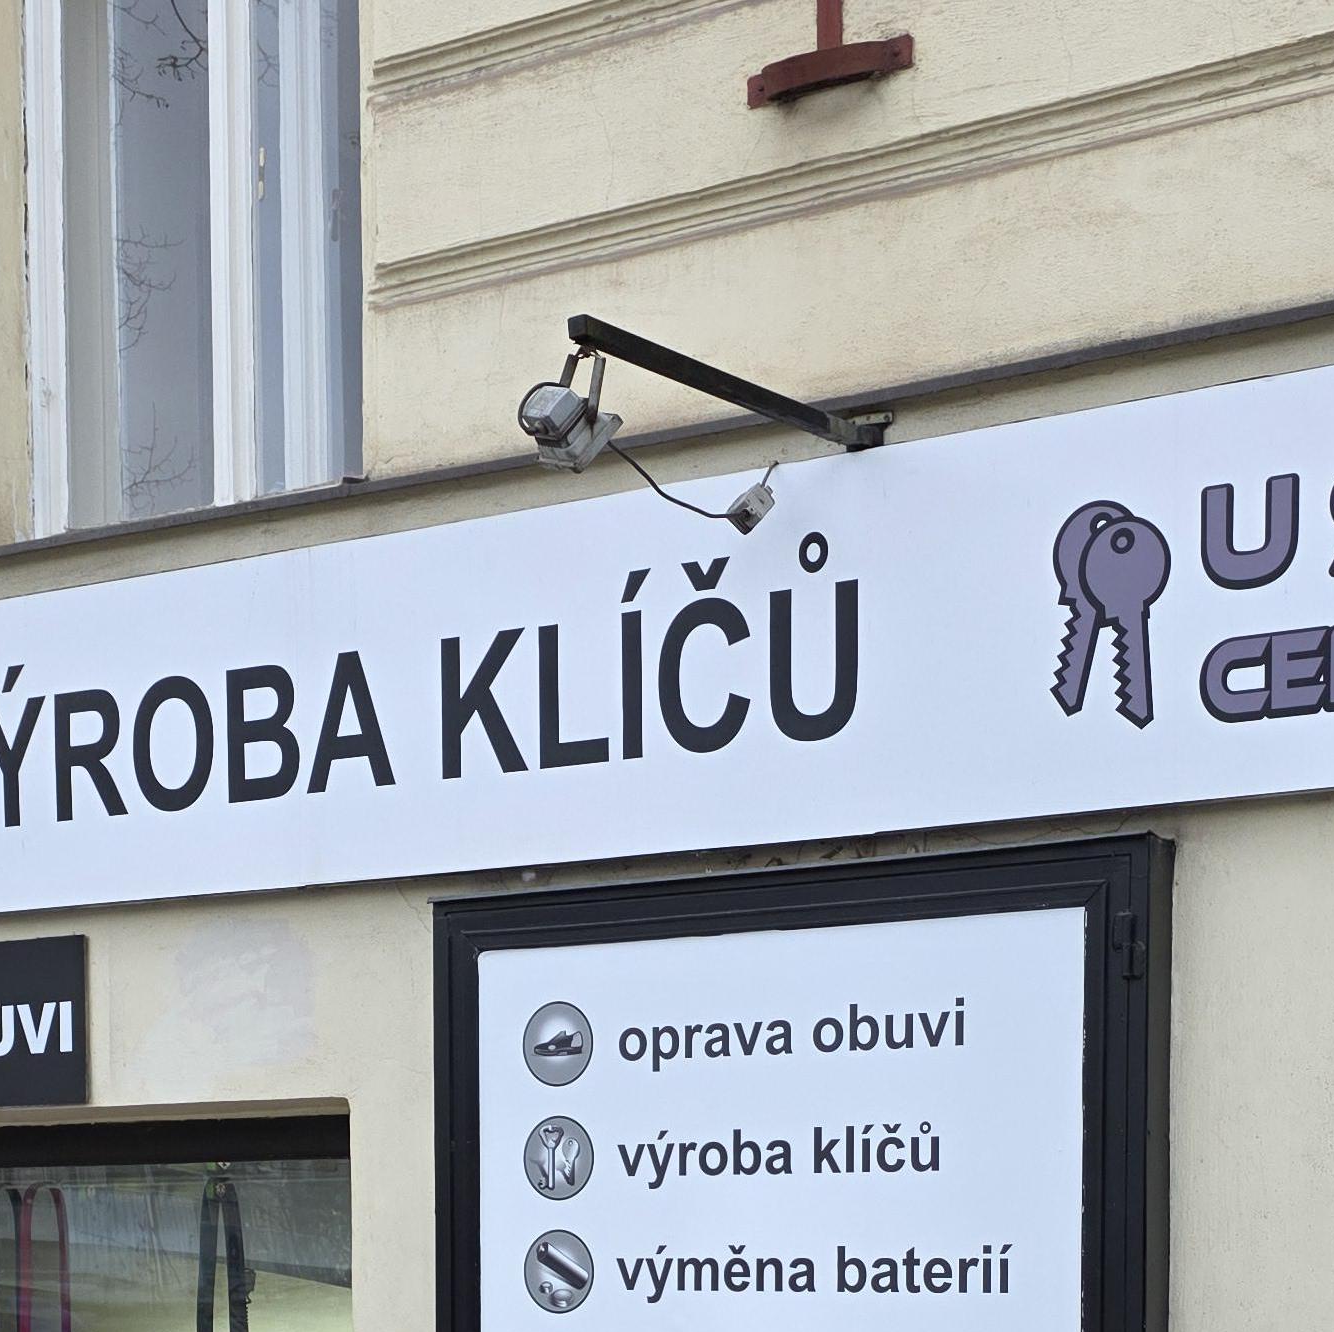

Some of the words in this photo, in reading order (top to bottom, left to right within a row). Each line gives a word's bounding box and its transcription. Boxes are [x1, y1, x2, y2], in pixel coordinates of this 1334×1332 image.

[1199, 470, 1301, 591] U
[439, 531, 860, 781] KLÍČŮ
[619, 1020, 792, 1072] oprava
[813, 998, 964, 1052] obuvi
[618, 1129, 792, 1189] výroba
[814, 1121, 939, 1173] klíčů
[617, 1245, 815, 1303] výměna
[837, 1244, 1012, 1293] baterií
